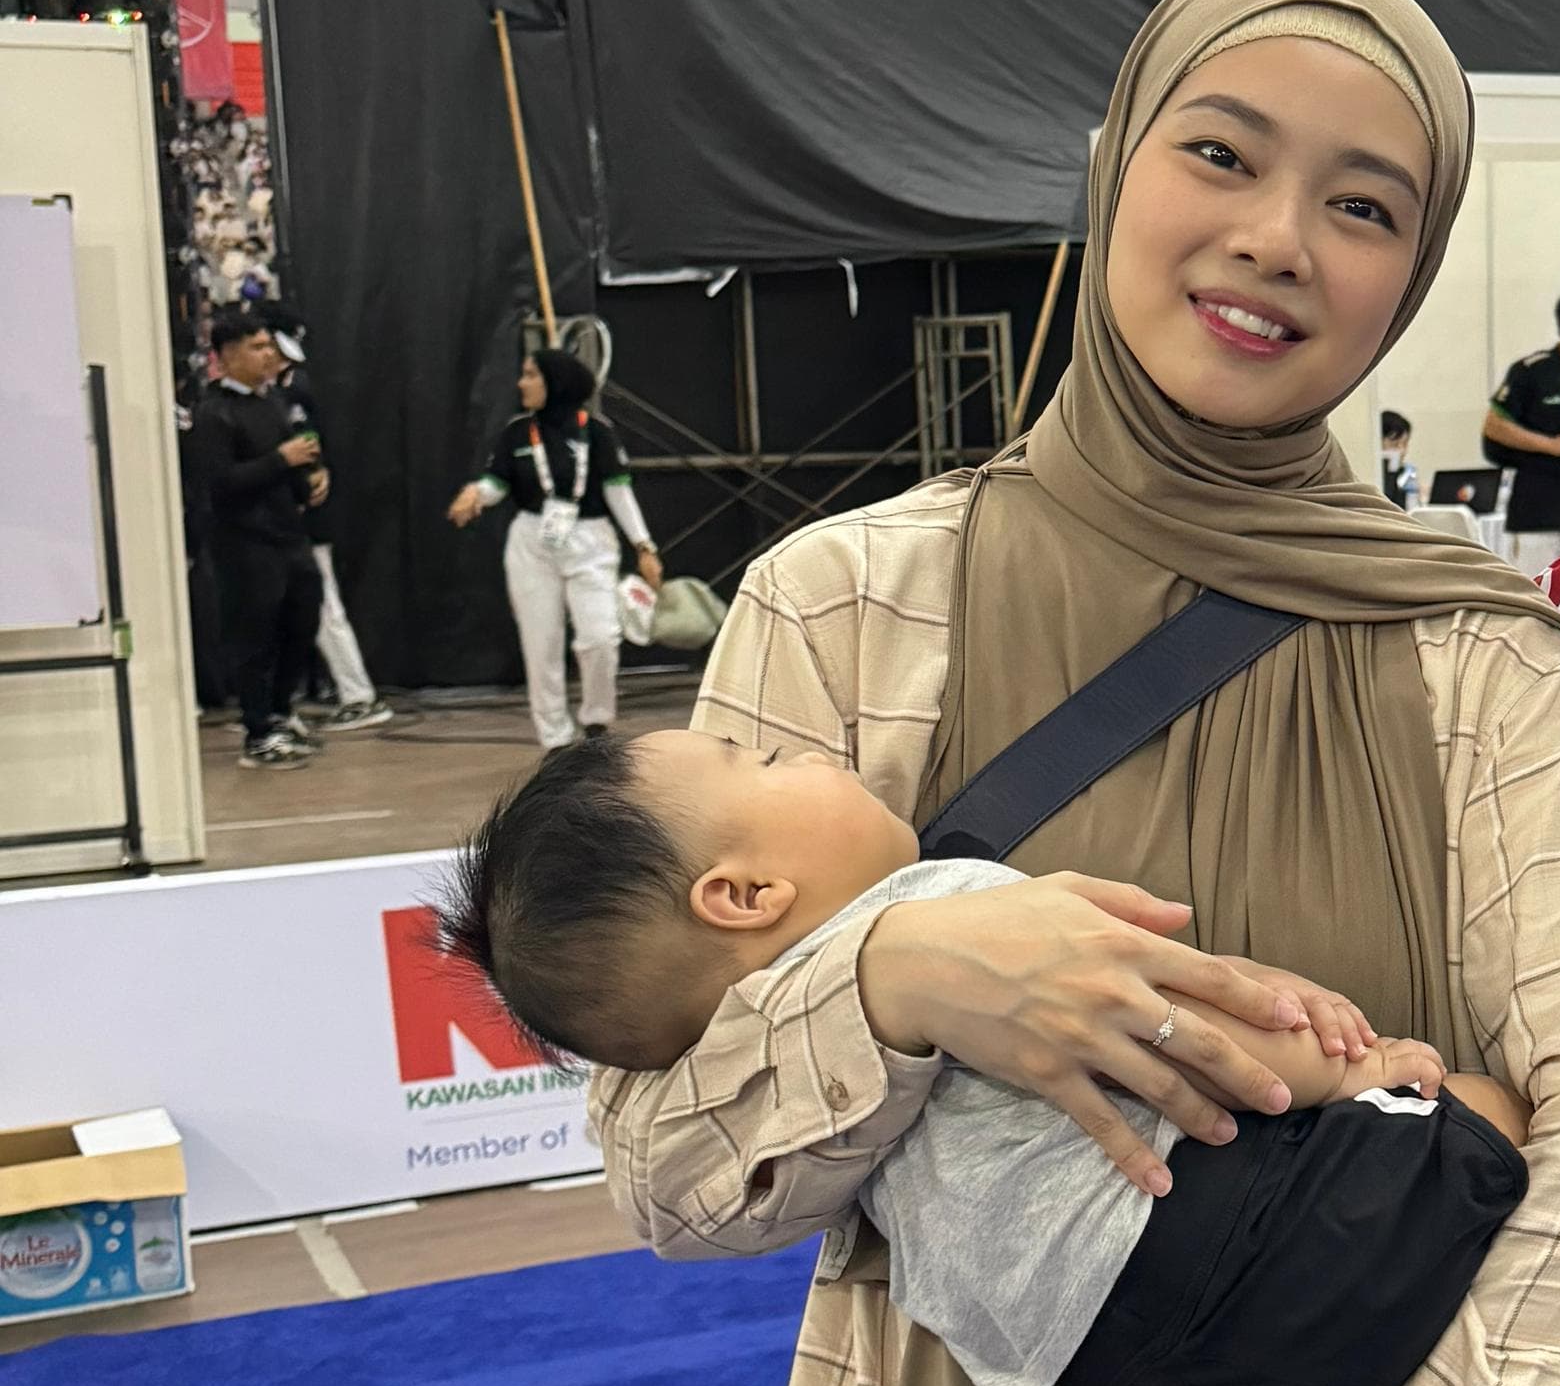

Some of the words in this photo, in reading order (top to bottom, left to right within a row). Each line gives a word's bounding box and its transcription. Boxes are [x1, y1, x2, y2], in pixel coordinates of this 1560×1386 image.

[406, 1072, 536, 1110] KAWASAN
[406, 1134, 532, 1168] Member
[539, 1123, 569, 1149] of
[27, 1235, 50, 1251] Le
